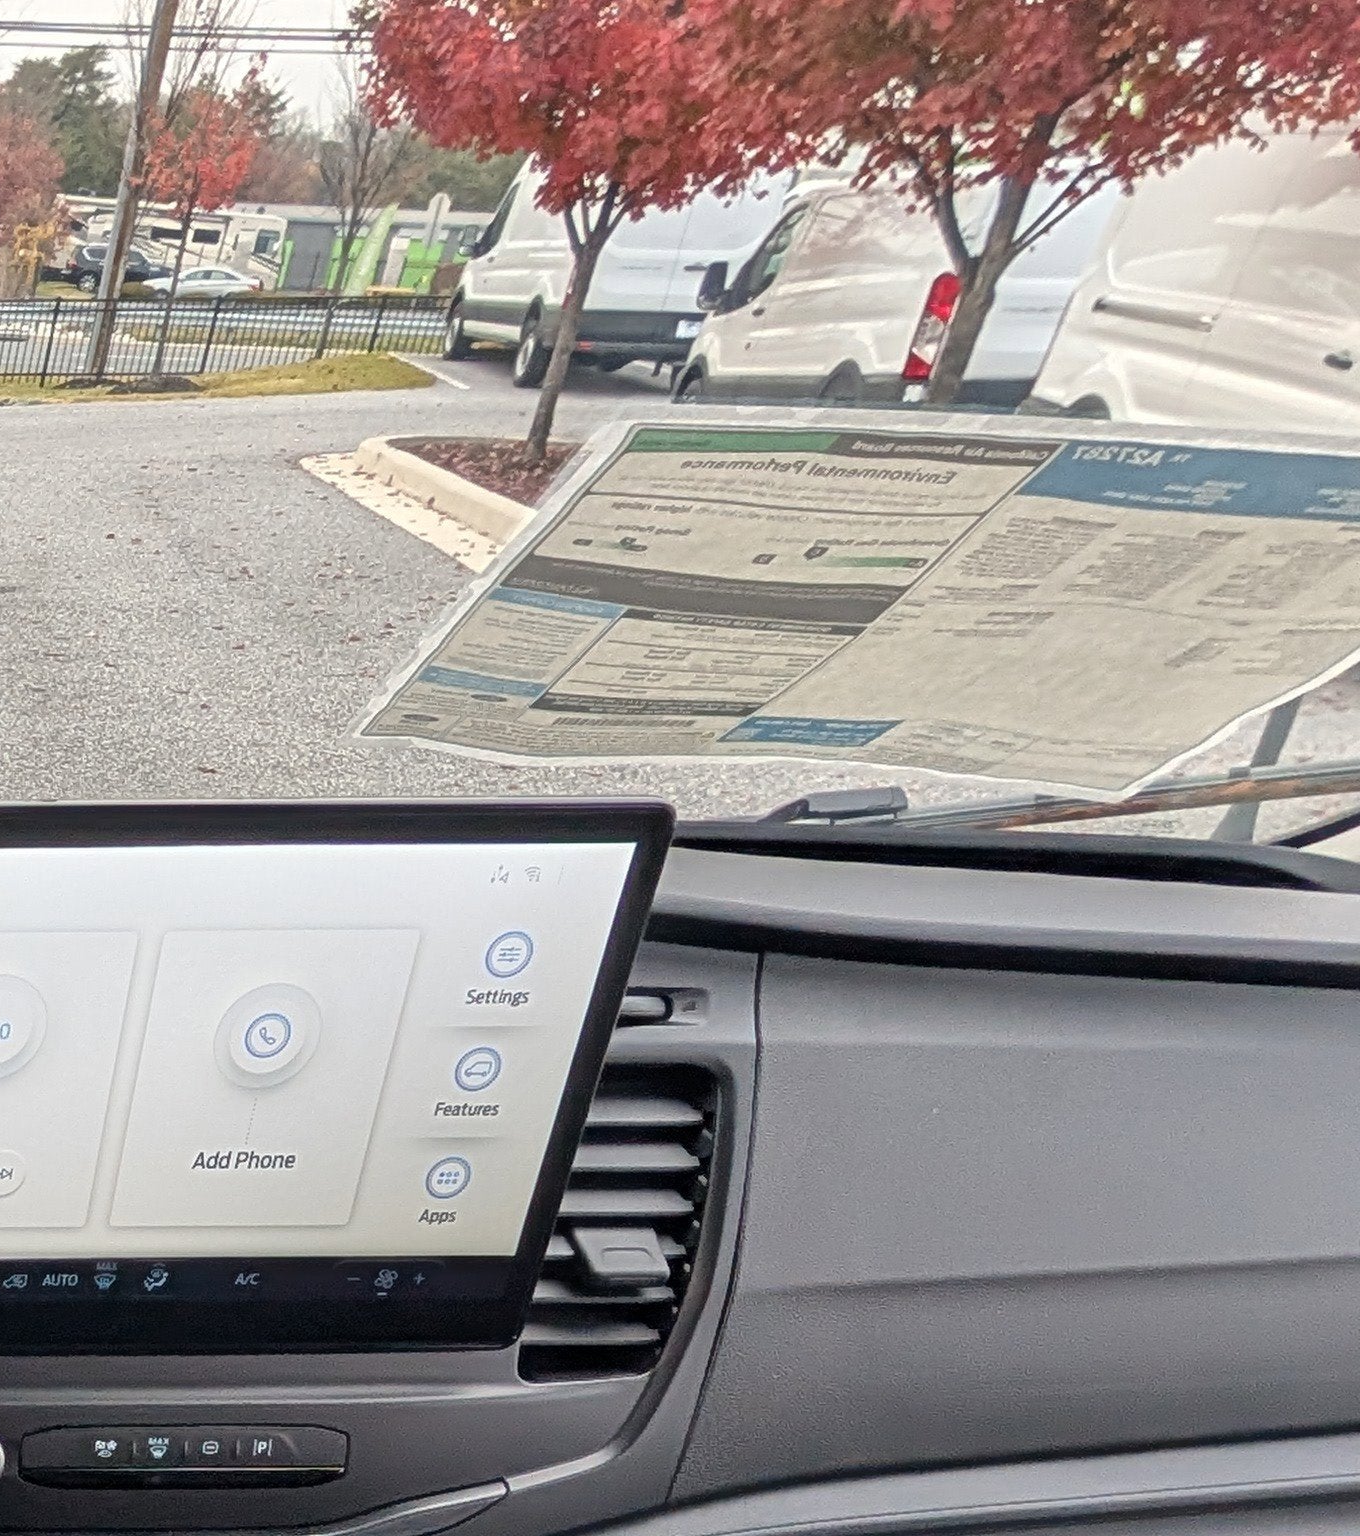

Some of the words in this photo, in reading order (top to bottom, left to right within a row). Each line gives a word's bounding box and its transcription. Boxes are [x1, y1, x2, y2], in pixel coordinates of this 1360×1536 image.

[465, 989, 530, 1007] Settings
[434, 1102, 499, 1117] Features
[191, 1150, 232, 1169] Add
[234, 1151, 296, 1169] Phone
[418, 1209, 456, 1225] Apps
[96, 1261, 118, 1271] MAX
[42, 1273, 79, 1287] AUTO
[235, 1273, 260, 1286] A/C
[148, 1437, 170, 1446] MAX
